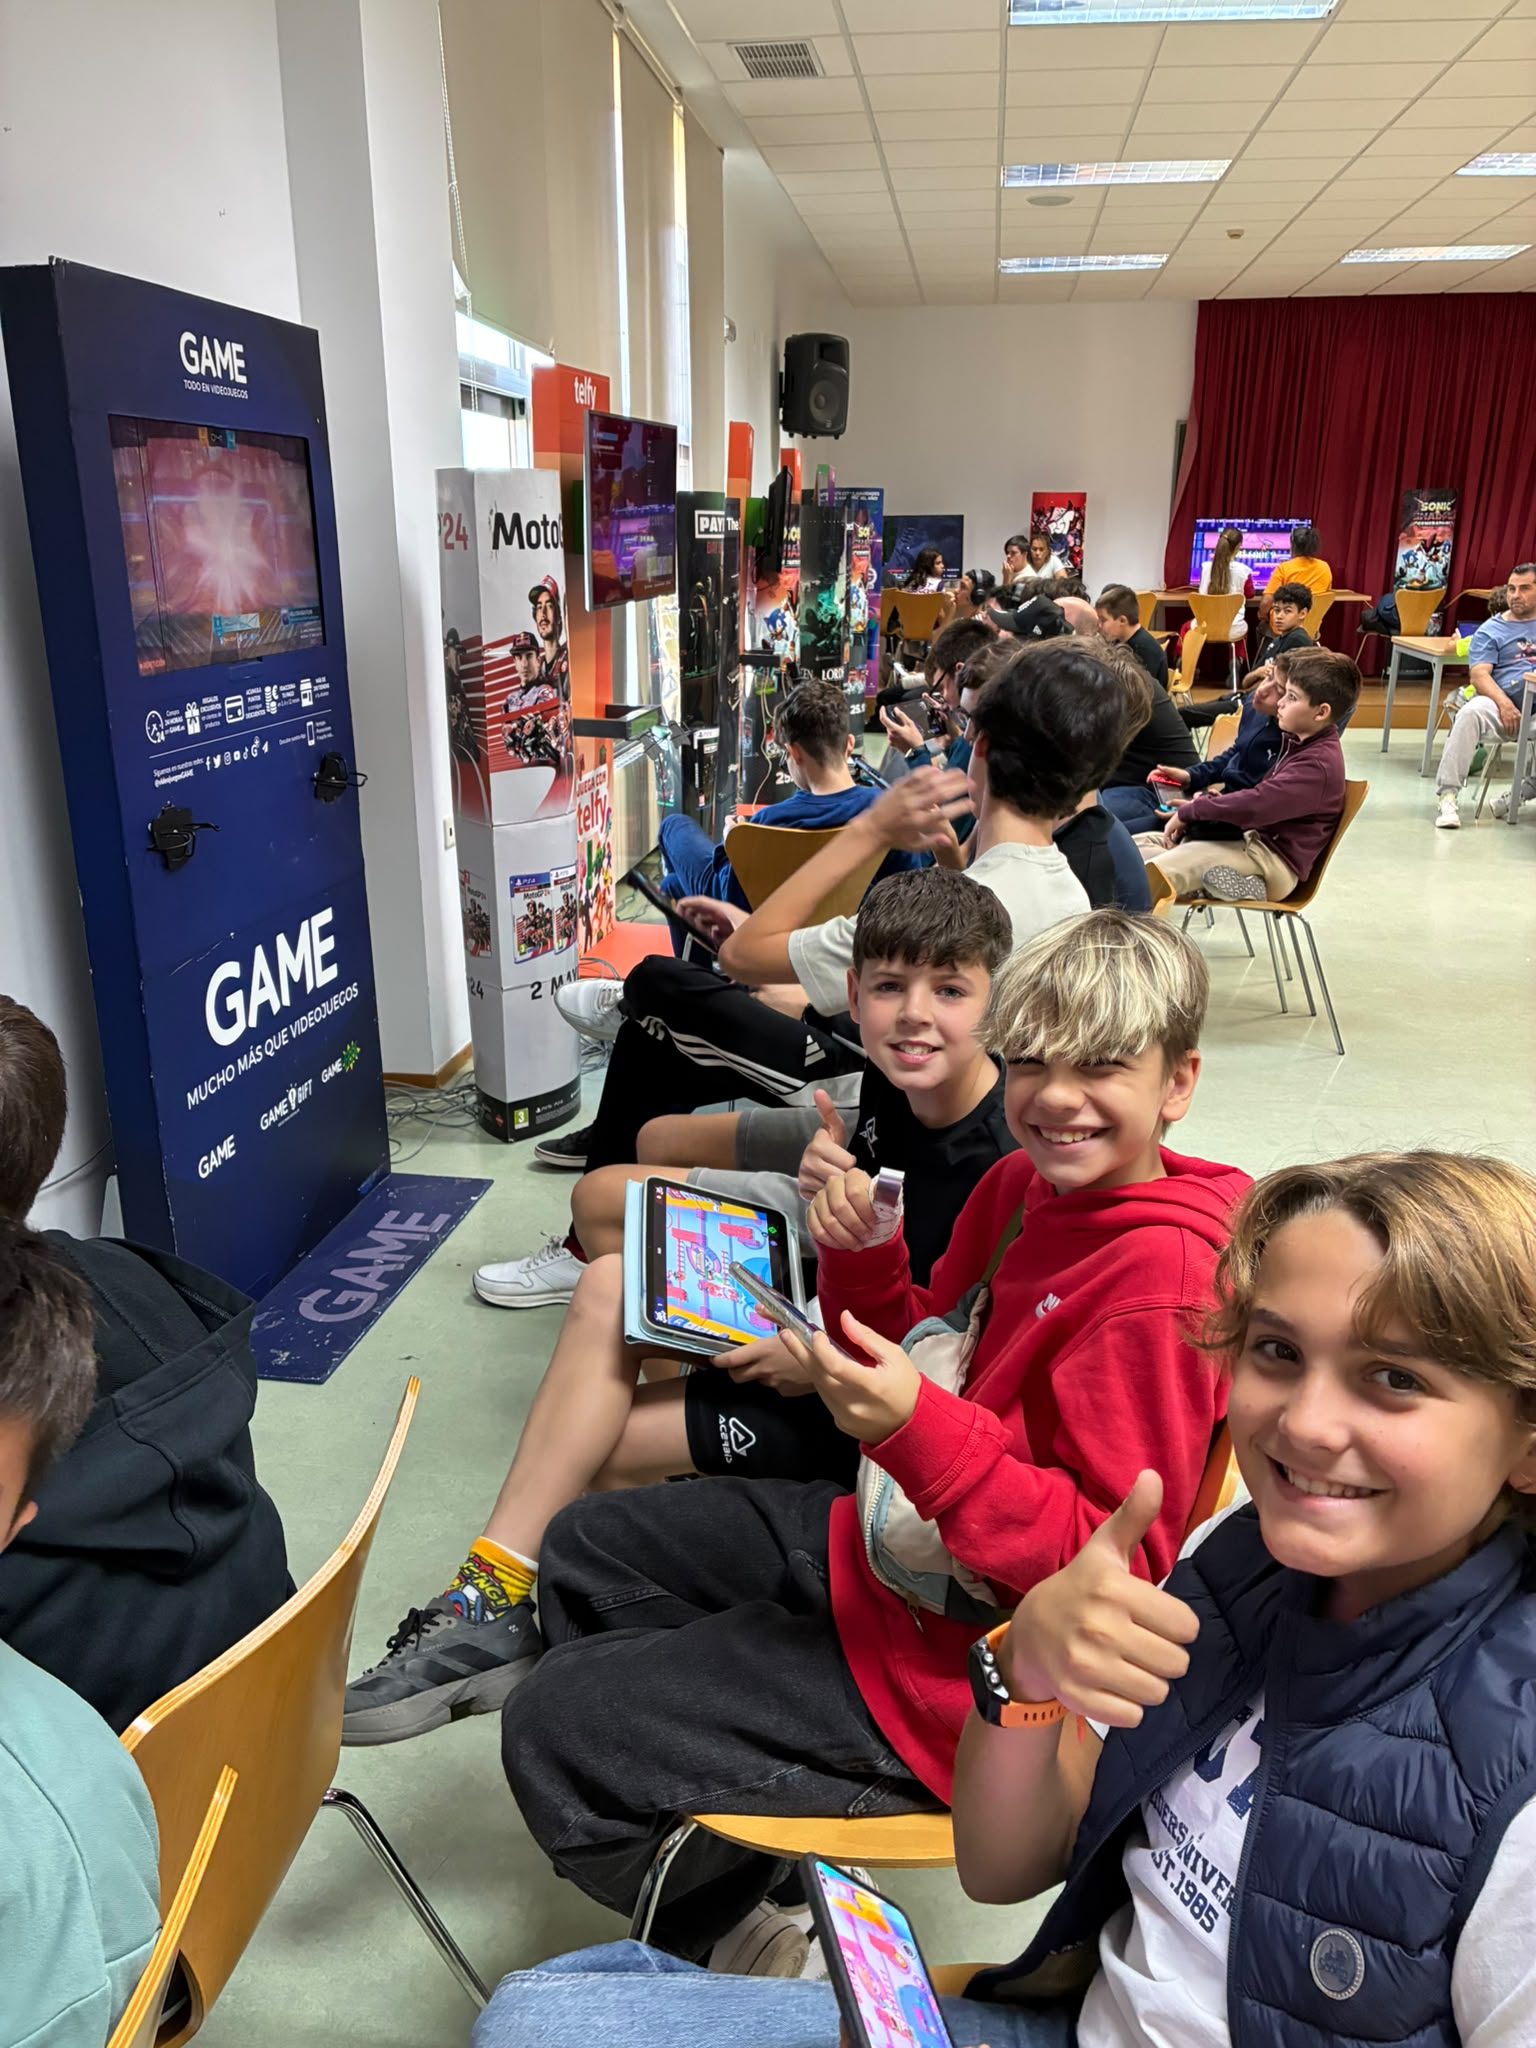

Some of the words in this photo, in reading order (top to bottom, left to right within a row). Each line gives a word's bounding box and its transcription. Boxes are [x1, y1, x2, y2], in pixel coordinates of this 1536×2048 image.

[179, 331, 248, 385] GAME
[183, 379, 201, 392] TODO
[201, 382, 211, 394] EN
[211, 384, 249, 400] VIDEOJUEGOS
[574, 375, 597, 411] telfy
[699, 516, 725, 532] PAY
[1420, 501, 1451, 511] SONIC
[492, 512, 562, 550] Moto
[858, 527, 869, 537] SO
[156, 731, 165, 743] 24
[577, 788, 607, 836] telfy
[205, 906, 338, 1046] GAME
[187, 1065, 235, 1110] MUCHO
[238, 1045, 263, 1076] MÁS
[264, 1028, 289, 1058] QUE
[290, 981, 359, 1039] VIDEOJUEGOS
[321, 1058, 343, 1083] GAME
[260, 1098, 289, 1131] GAME
[297, 1078, 313, 1104] GIFT
[197, 1134, 236, 1180] GAME
[298, 1209, 452, 1323] GAME
